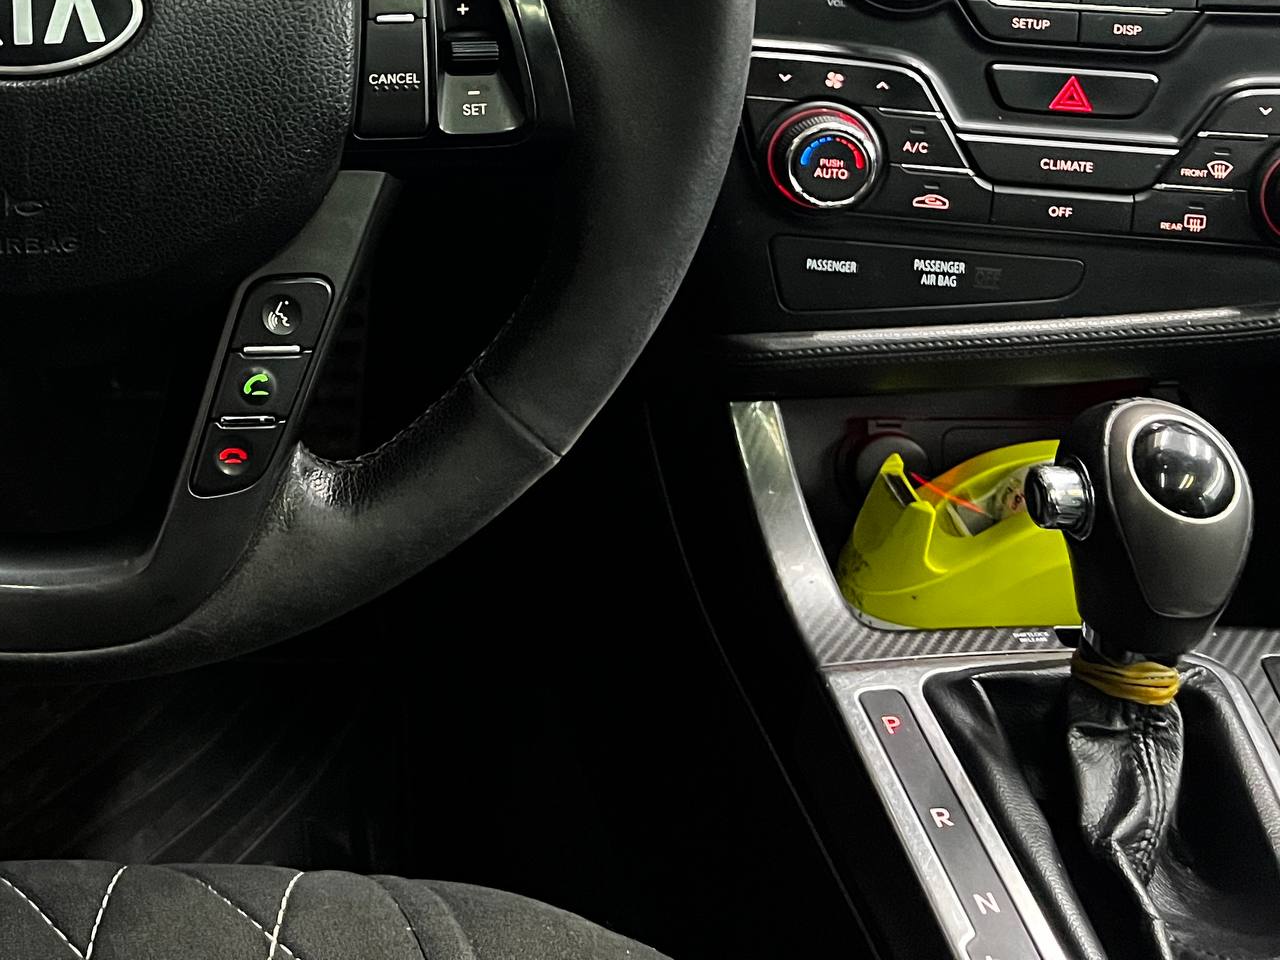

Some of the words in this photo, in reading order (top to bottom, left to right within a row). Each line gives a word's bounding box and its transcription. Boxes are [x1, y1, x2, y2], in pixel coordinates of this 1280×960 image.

[1012, 18, 1051, 30] SETUP
[1113, 24, 1142, 36] DISP
[368, 72, 421, 86] CANCEL
[462, 103, 488, 116] SET
[903, 141, 929, 154] A/C
[820, 158, 844, 168] PUSH
[1040, 158, 1094, 173] CLIMATE
[814, 168, 849, 180] AUTO
[1181, 168, 1208, 178] FRONT
[1048, 206, 1073, 218] OFF
[1160, 222, 1183, 231] REAR
[806, 258, 857, 273] PASSENGER
[914, 259, 966, 274] PASSENGER
[921, 274, 936, 286] AIR
[937, 275, 957, 288] BAG
[881, 715, 901, 734] P
[929, 807, 955, 828] R
[972, 892, 1001, 915] N
